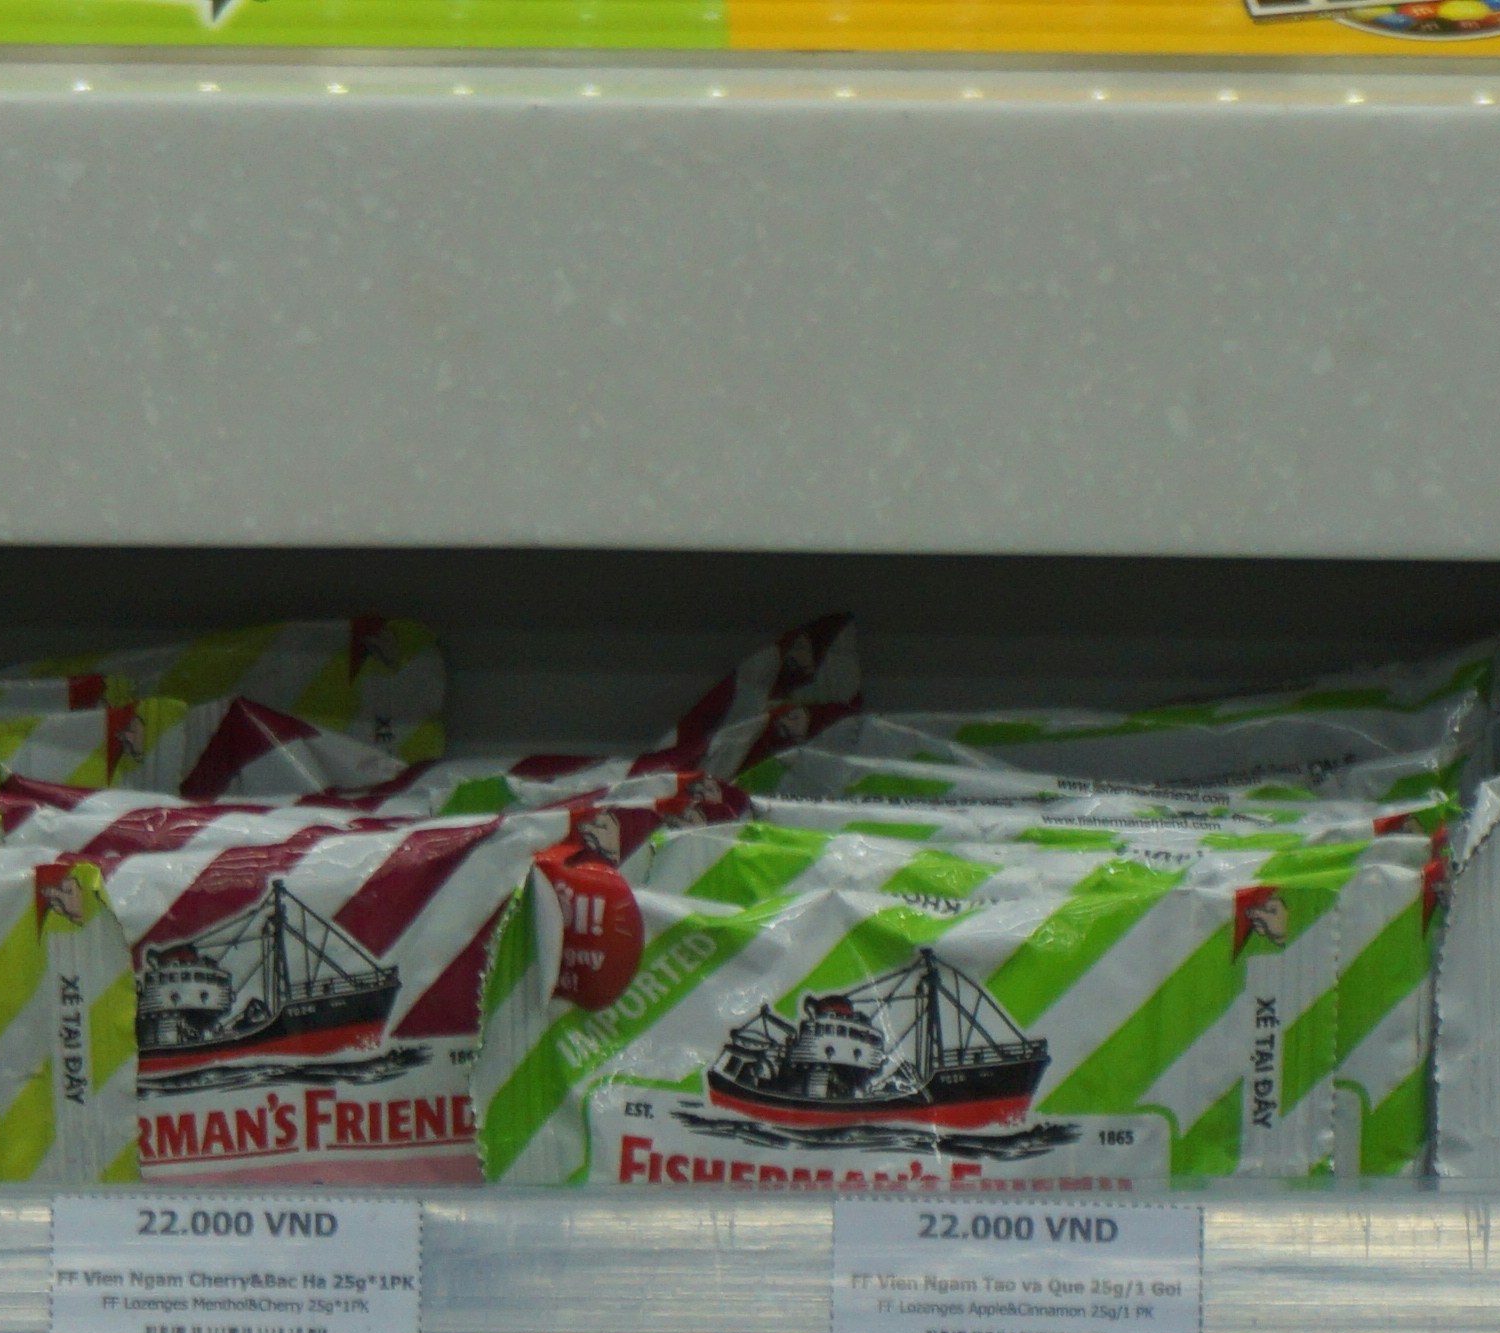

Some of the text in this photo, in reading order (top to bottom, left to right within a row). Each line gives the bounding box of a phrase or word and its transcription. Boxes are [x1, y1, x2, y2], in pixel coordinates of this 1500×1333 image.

[557, 931, 718, 1068] IMPORTED
[624, 1101, 655, 1120] EST.
[1099, 1130, 1135, 1147] 1865
[137, 1209, 338, 1238] 22.000 VND
[918, 1213, 1119, 1243] 22.000 VND
